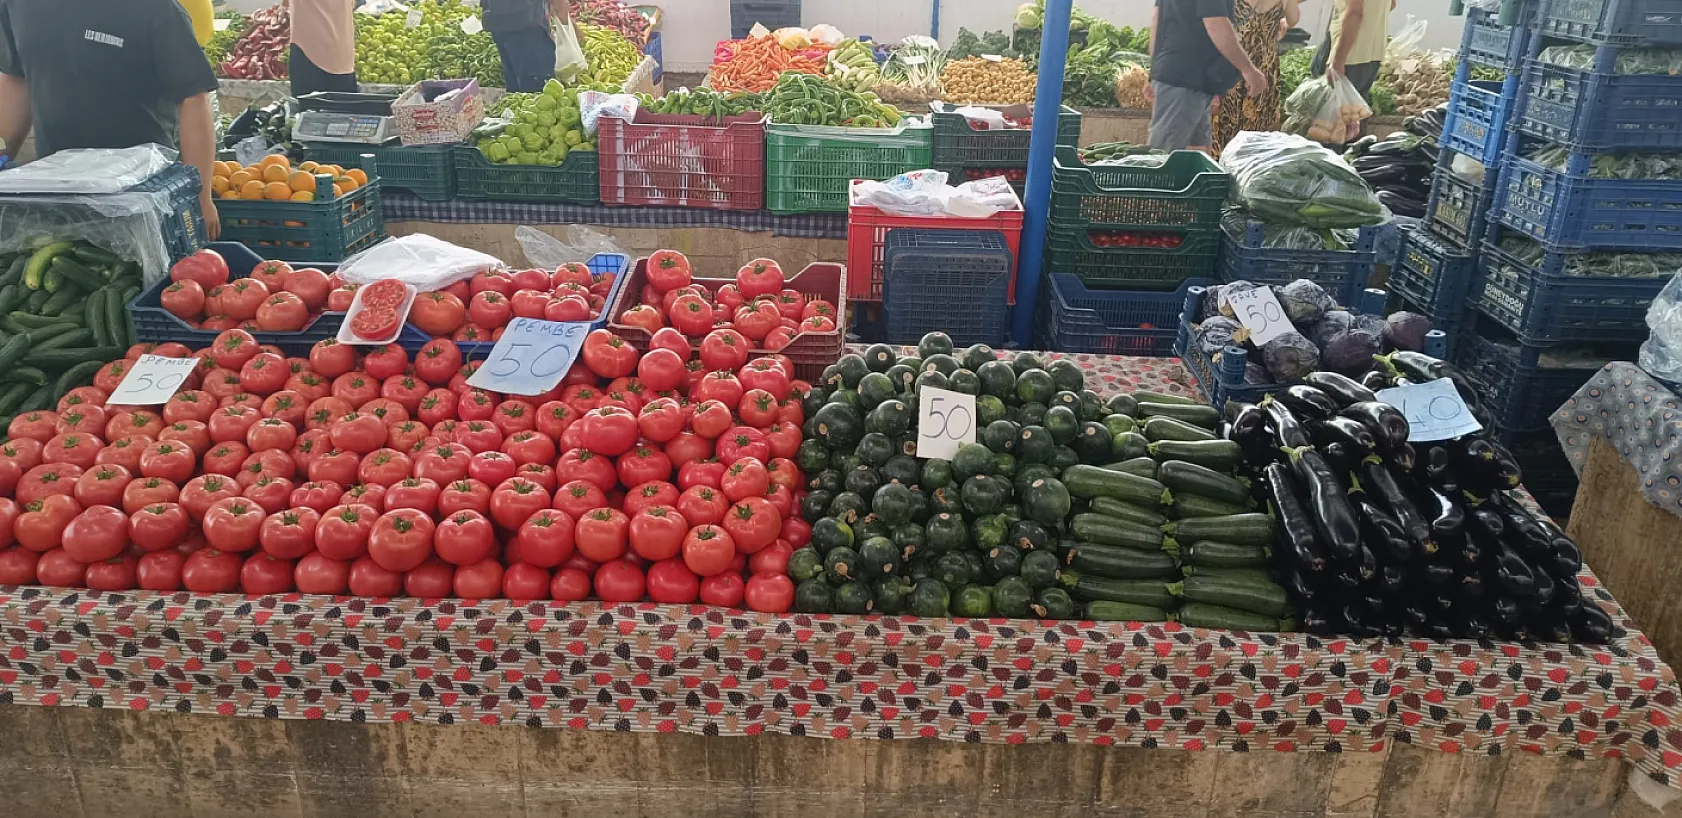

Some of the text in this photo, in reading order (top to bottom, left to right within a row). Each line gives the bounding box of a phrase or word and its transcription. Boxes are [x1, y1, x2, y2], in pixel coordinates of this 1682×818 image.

[514, 318, 583, 338] PEMBE
[1246, 301, 1281, 335] 50
[141, 356, 193, 366] PEMBE
[489, 343, 571, 378] 50
[124, 372, 184, 393] 50
[922, 397, 972, 440] 50
